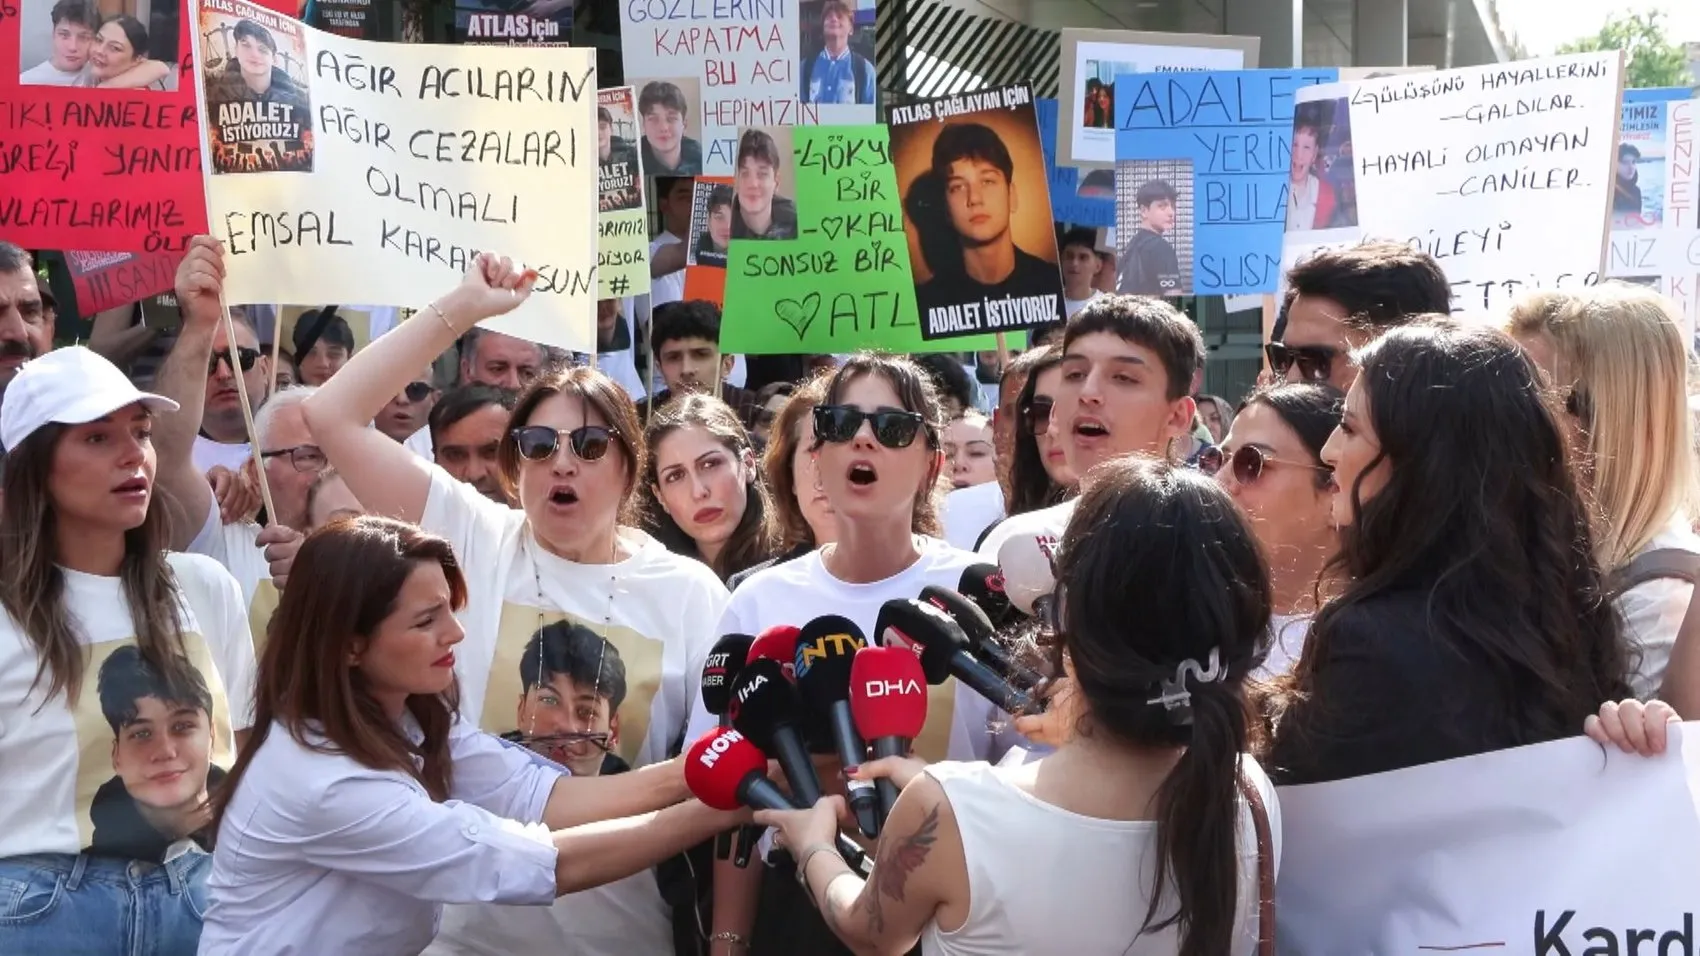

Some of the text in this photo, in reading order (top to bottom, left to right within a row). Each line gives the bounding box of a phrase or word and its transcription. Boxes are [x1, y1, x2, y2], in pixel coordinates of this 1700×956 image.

[468, 14, 559, 42] ATLAS için
[654, 24, 785, 56] KAPATMA
[316, 50, 595, 103] AĞIR ACILARIN
[705, 59, 791, 87] BU ACI
[1481, 60, 1608, 91] HAYALLERİNİ
[219, 101, 294, 126] ADALET
[703, 94, 819, 126] HEPİMİZİN
[892, 84, 1030, 126] ATLAS ÇAĞLAYAN İÇİN
[222, 122, 300, 143] İSTİYORUZ!
[320, 105, 577, 168] AĞIR CEZALARI
[1362, 126, 1590, 177] HAYALİ OLMAYAN
[366, 165, 518, 223] OLMALI
[837, 171, 888, 202] BİR
[743, 240, 903, 277] SONSUZ BİR
[1611, 234, 1656, 270] NİZ
[523, 262, 598, 296] SUN
[928, 292, 1061, 335] ADALET İSTİYORUZ
[803, 632, 866, 668] NTV
[865, 679, 922, 698] DHA
[700, 728, 745, 769] NOW
[1534, 909, 1700, 956] Kard
